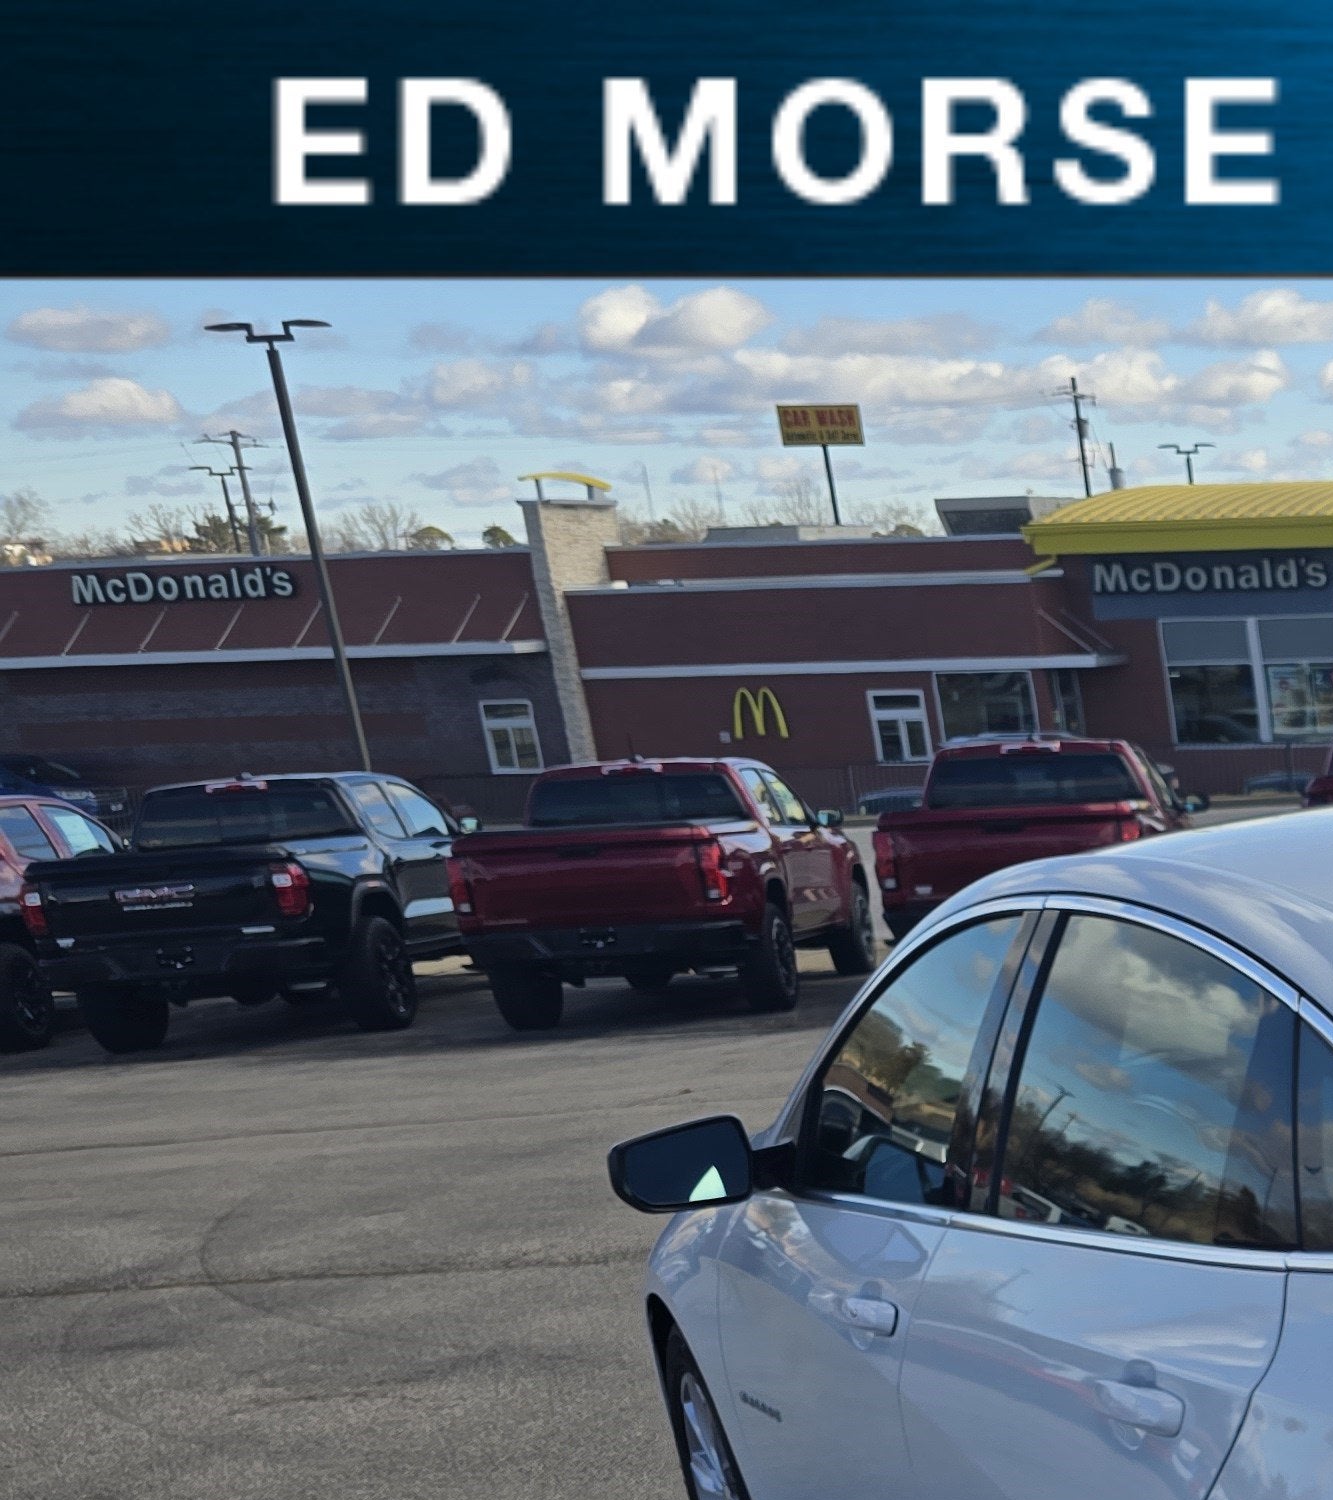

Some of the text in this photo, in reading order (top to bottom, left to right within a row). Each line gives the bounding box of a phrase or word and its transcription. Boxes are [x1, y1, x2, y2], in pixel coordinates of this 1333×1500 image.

[815, 409, 856, 427] WASH
[71, 567, 294, 605] McDonald's
[1093, 557, 1329, 593] McDonald's
